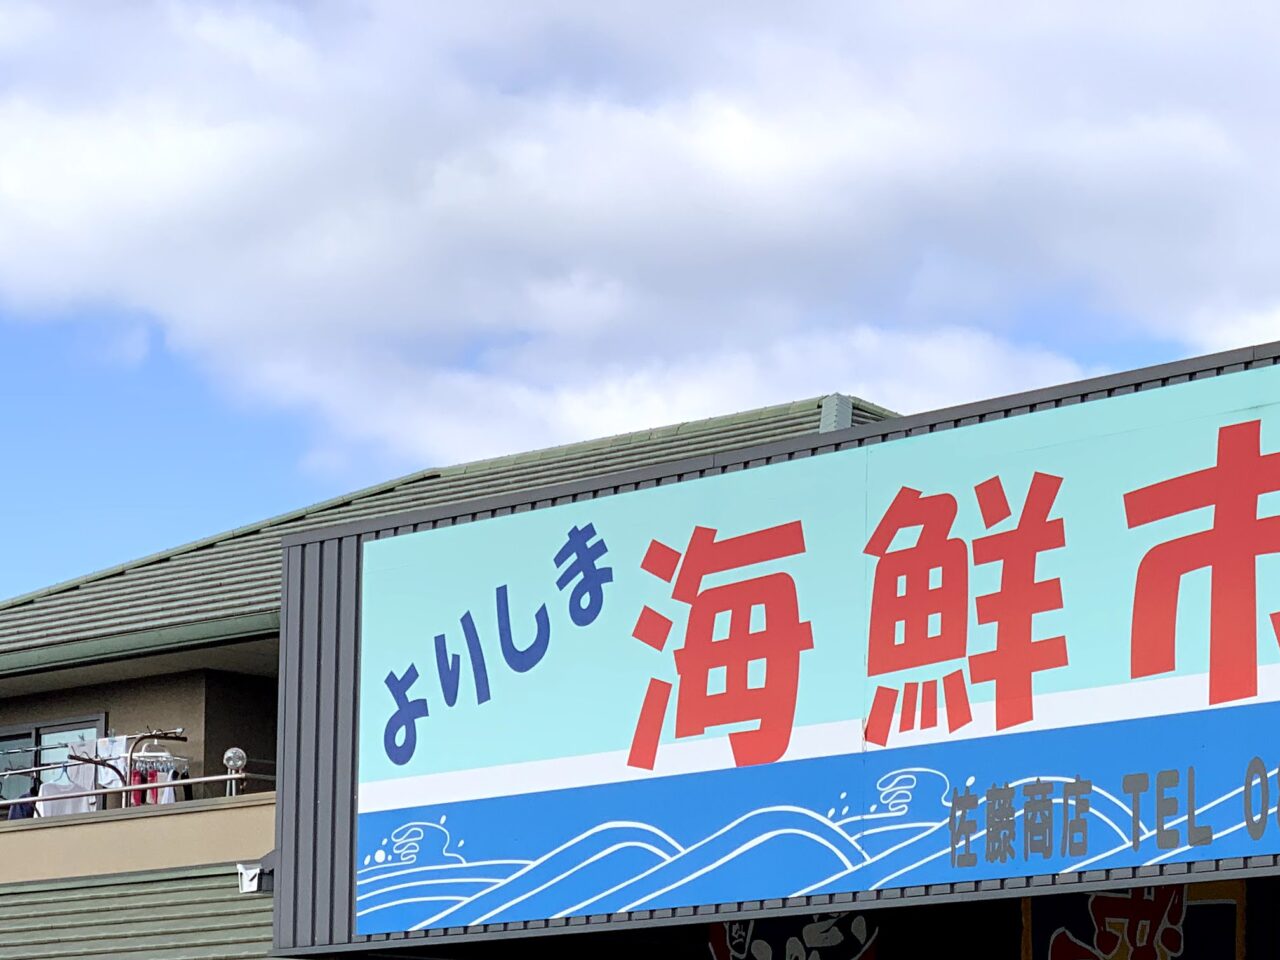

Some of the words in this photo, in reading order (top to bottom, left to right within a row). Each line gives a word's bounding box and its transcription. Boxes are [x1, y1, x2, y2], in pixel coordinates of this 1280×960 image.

[383, 522, 614, 766] よりしま
[949, 774, 1093, 868] 佐藤商店
[1122, 765, 1213, 852] TEL
